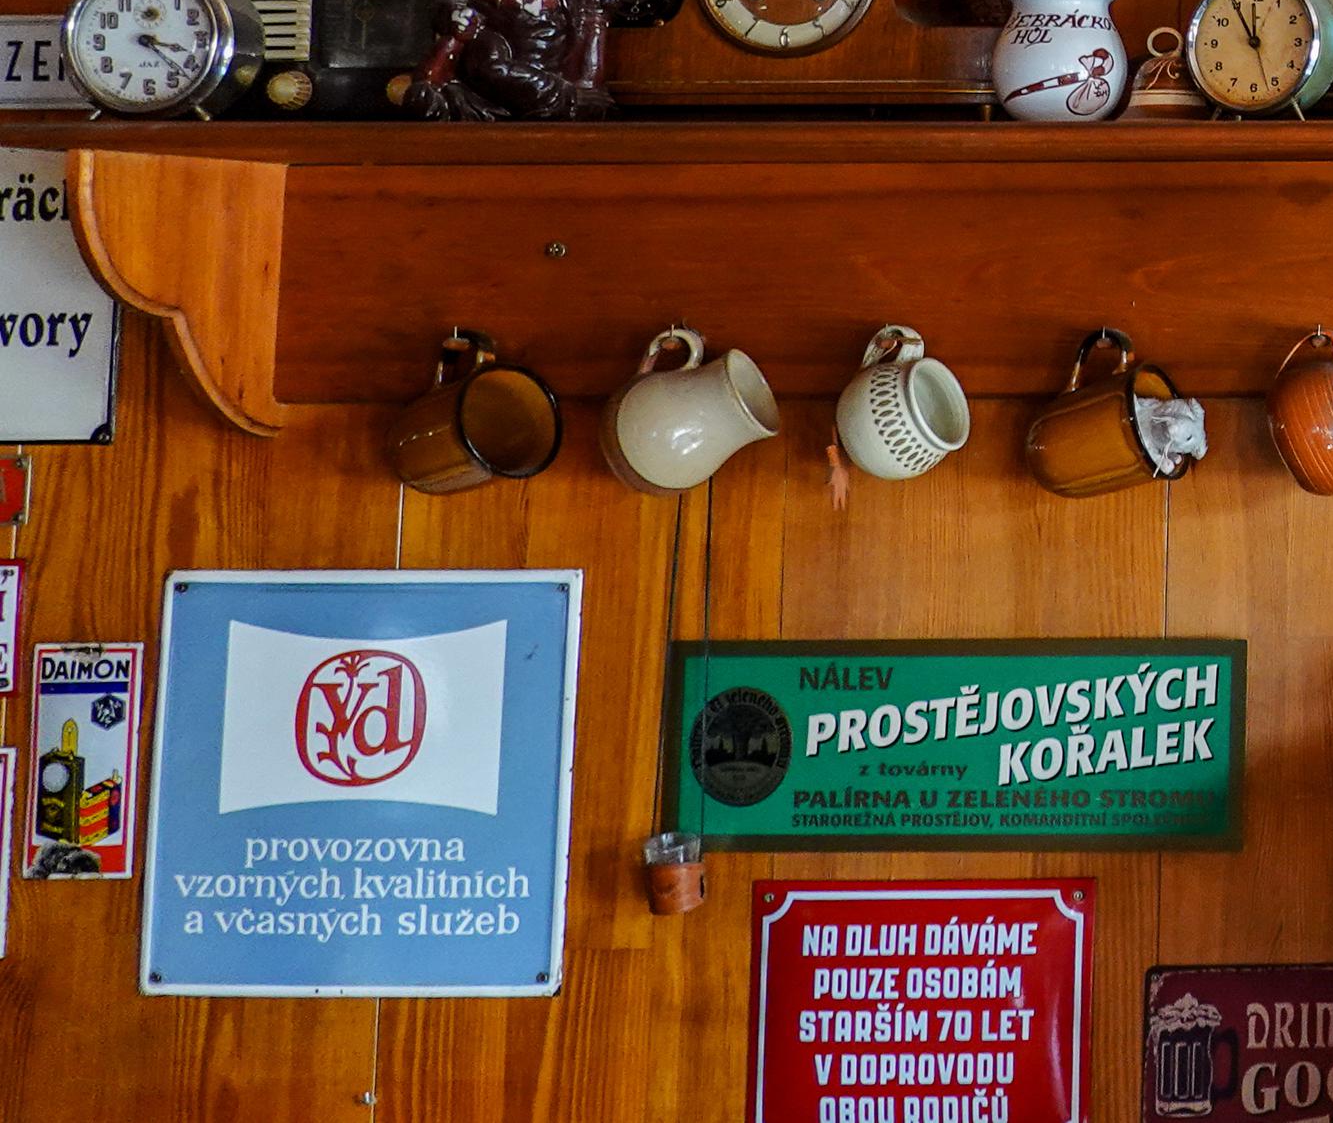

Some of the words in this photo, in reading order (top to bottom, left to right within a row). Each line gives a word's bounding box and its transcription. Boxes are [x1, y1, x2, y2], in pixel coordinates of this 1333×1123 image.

[100, 12, 118, 29] 10
[41, 657, 130, 681] DAIMON
[800, 661, 893, 692] NÁLEV
[805, 663, 1220, 757] PROSTĚJOVSKÝCH
[859, 764, 870, 775] z
[879, 761, 968, 780] továrny
[998, 719, 1215, 787] KOŘALEK
[793, 786, 911, 808] PALÍRNA
[919, 791, 938, 808] U
[947, 785, 1091, 809] ZELENÉHO
[245, 835, 465, 870] provozovna
[354, 867, 529, 899] kvalitních
[184, 909, 203, 935] a
[215, 904, 382, 943] včasných
[398, 904, 519, 935] služeb
[802, 924, 839, 957] NA
[845, 923, 916, 957] DLUH
[924, 915, 1038, 957] DÁVÁME
[813, 967, 899, 1001] POUZE
[906, 958, 1023, 1001] OSOBÁM
[799, 1003, 928, 1044] STARŠÍM
[936, 1010, 972, 1043] 70
[981, 1009, 1035, 1043] LET
[814, 1054, 834, 1086] V
[840, 1052, 1015, 1086] DOPROVODU
[819, 1095, 895, 1123] OBOU
[903, 1086, 1010, 1123] RODIČŮ
